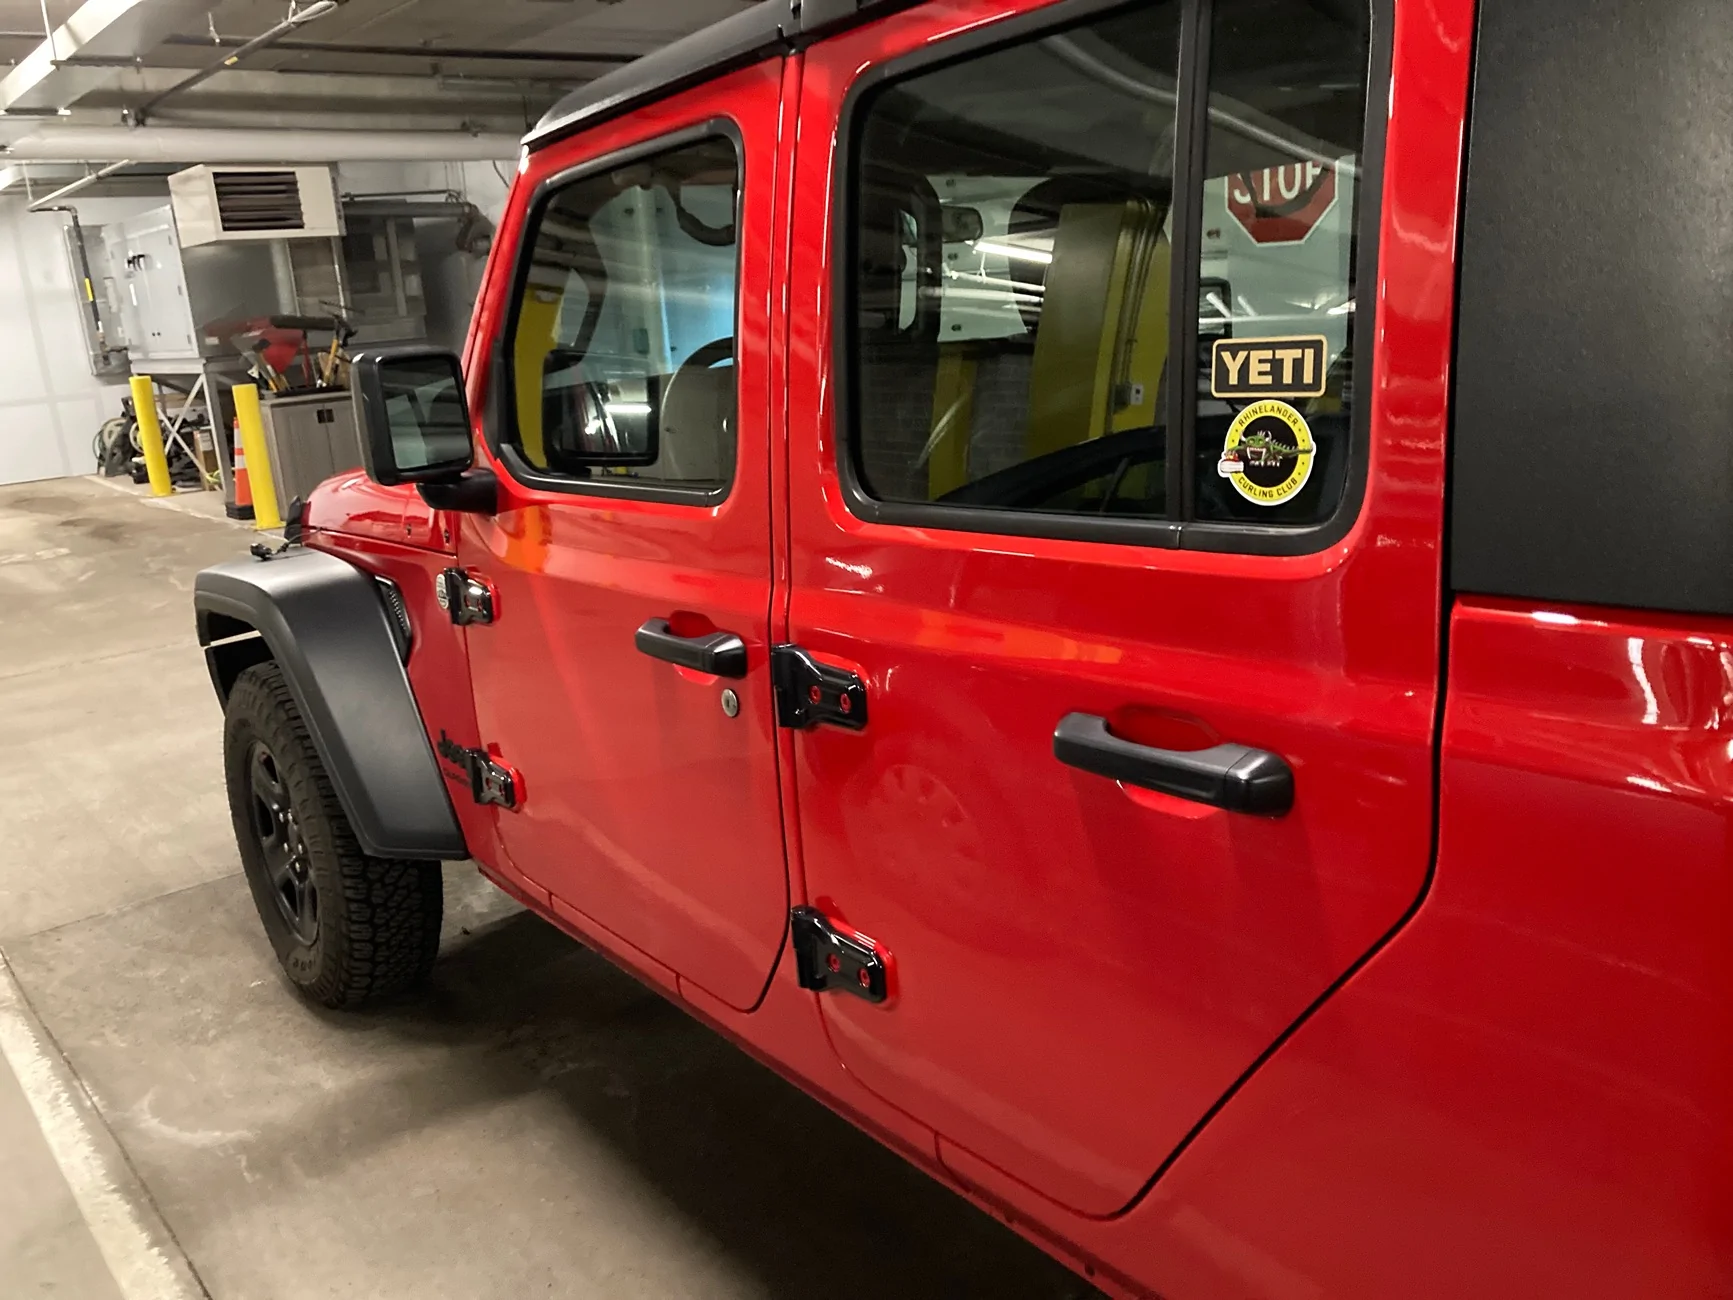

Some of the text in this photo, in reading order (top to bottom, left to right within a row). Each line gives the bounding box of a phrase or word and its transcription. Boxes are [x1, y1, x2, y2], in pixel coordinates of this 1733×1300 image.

[1220, 348, 1315, 386] YETI
[1238, 405, 1299, 427] RHINELANDER
[1238, 476, 1298, 498] CURLING CLUB
